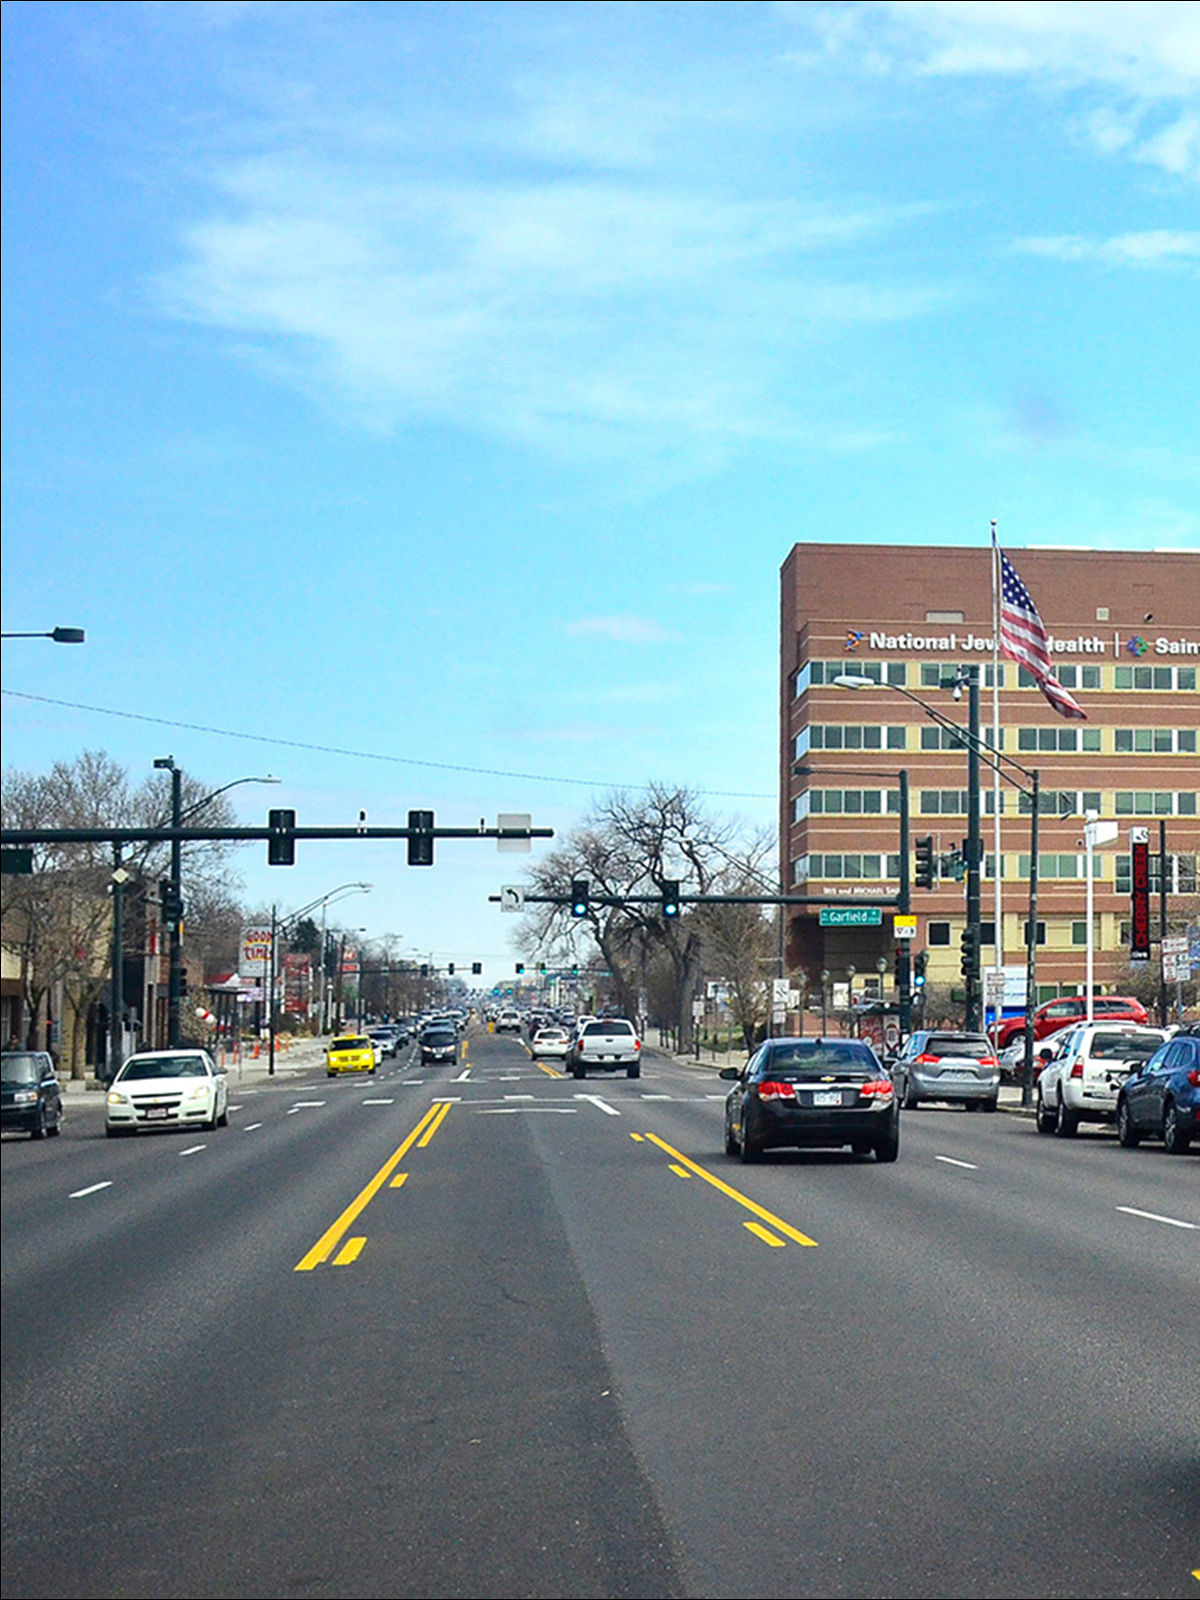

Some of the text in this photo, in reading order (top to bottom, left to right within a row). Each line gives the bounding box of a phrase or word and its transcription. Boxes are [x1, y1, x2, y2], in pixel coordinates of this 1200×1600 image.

[869, 632, 956, 651] National
[961, 635, 1001, 651] Jew
[1134, 844, 1148, 889] CREEK
[829, 911, 868, 922] Garfield
[1134, 892, 1148, 948] CHERRY
